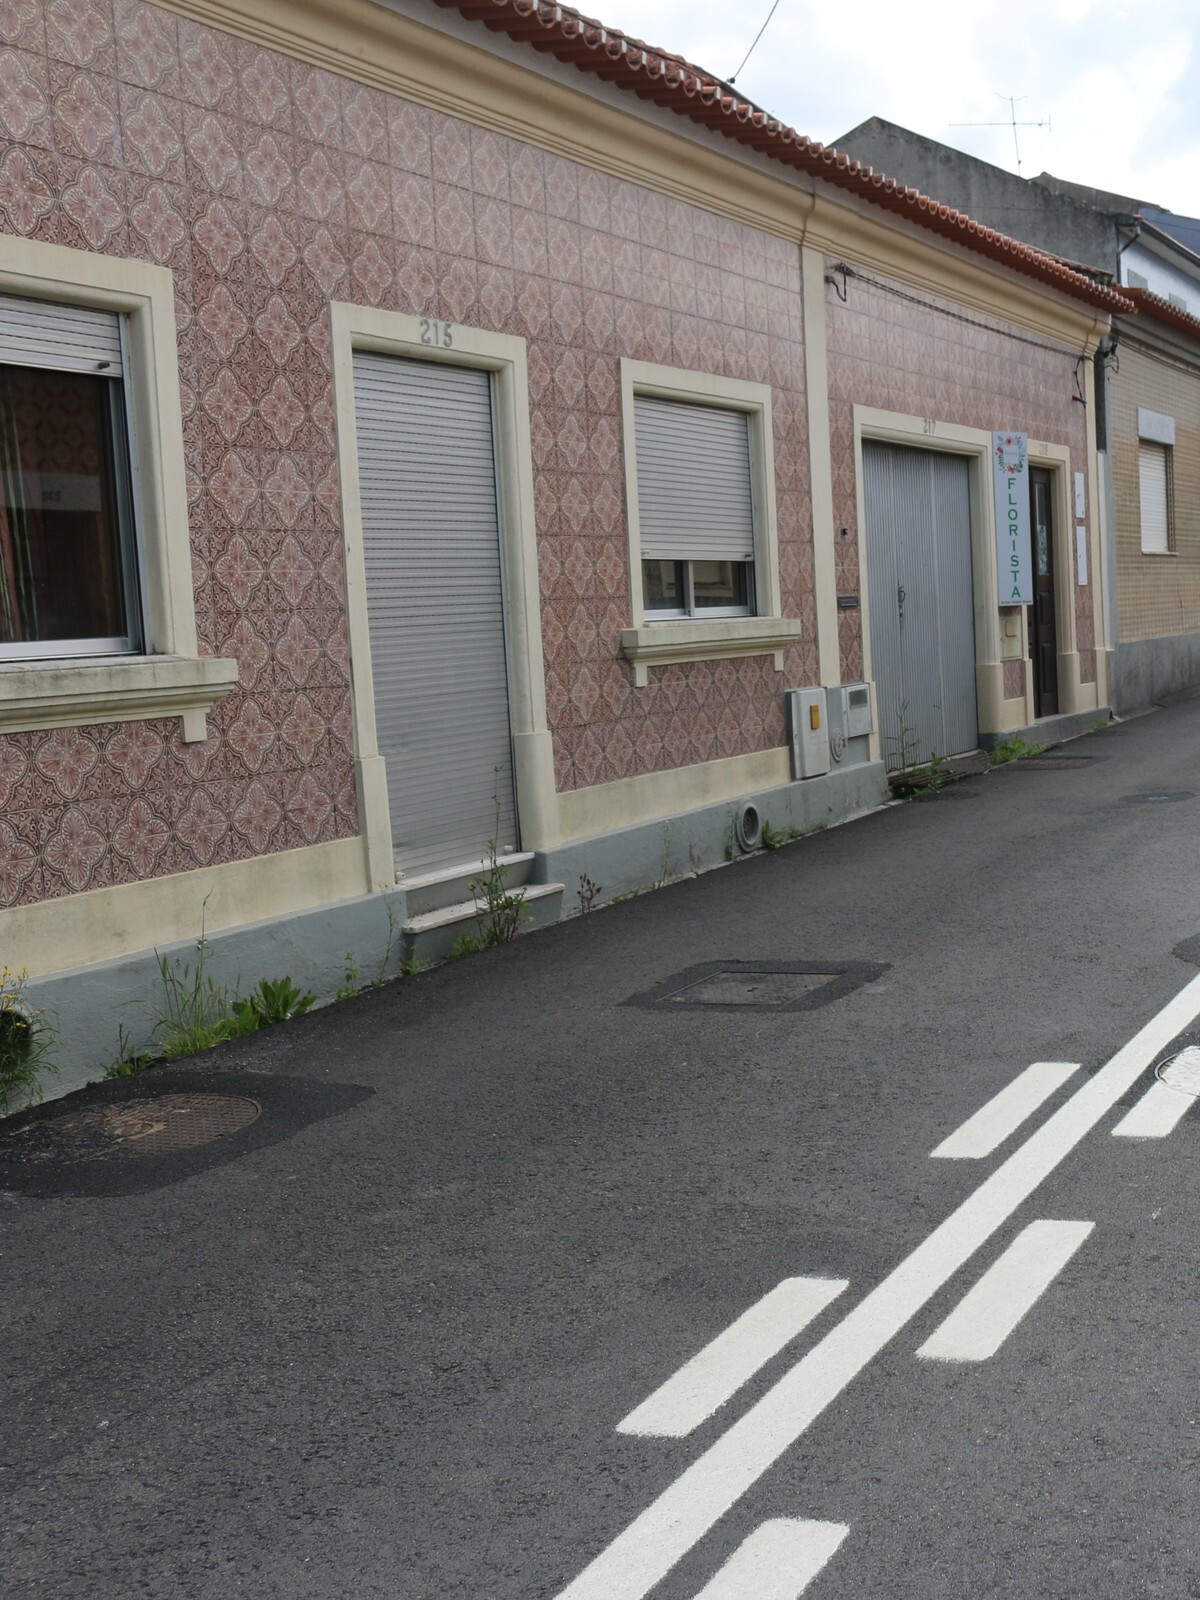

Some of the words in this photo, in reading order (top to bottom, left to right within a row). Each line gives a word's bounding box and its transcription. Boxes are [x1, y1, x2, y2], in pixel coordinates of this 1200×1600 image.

[420, 319, 453, 347] 215
[922, 418, 936, 434] 217
[1007, 478, 1021, 598] FLORISTA
